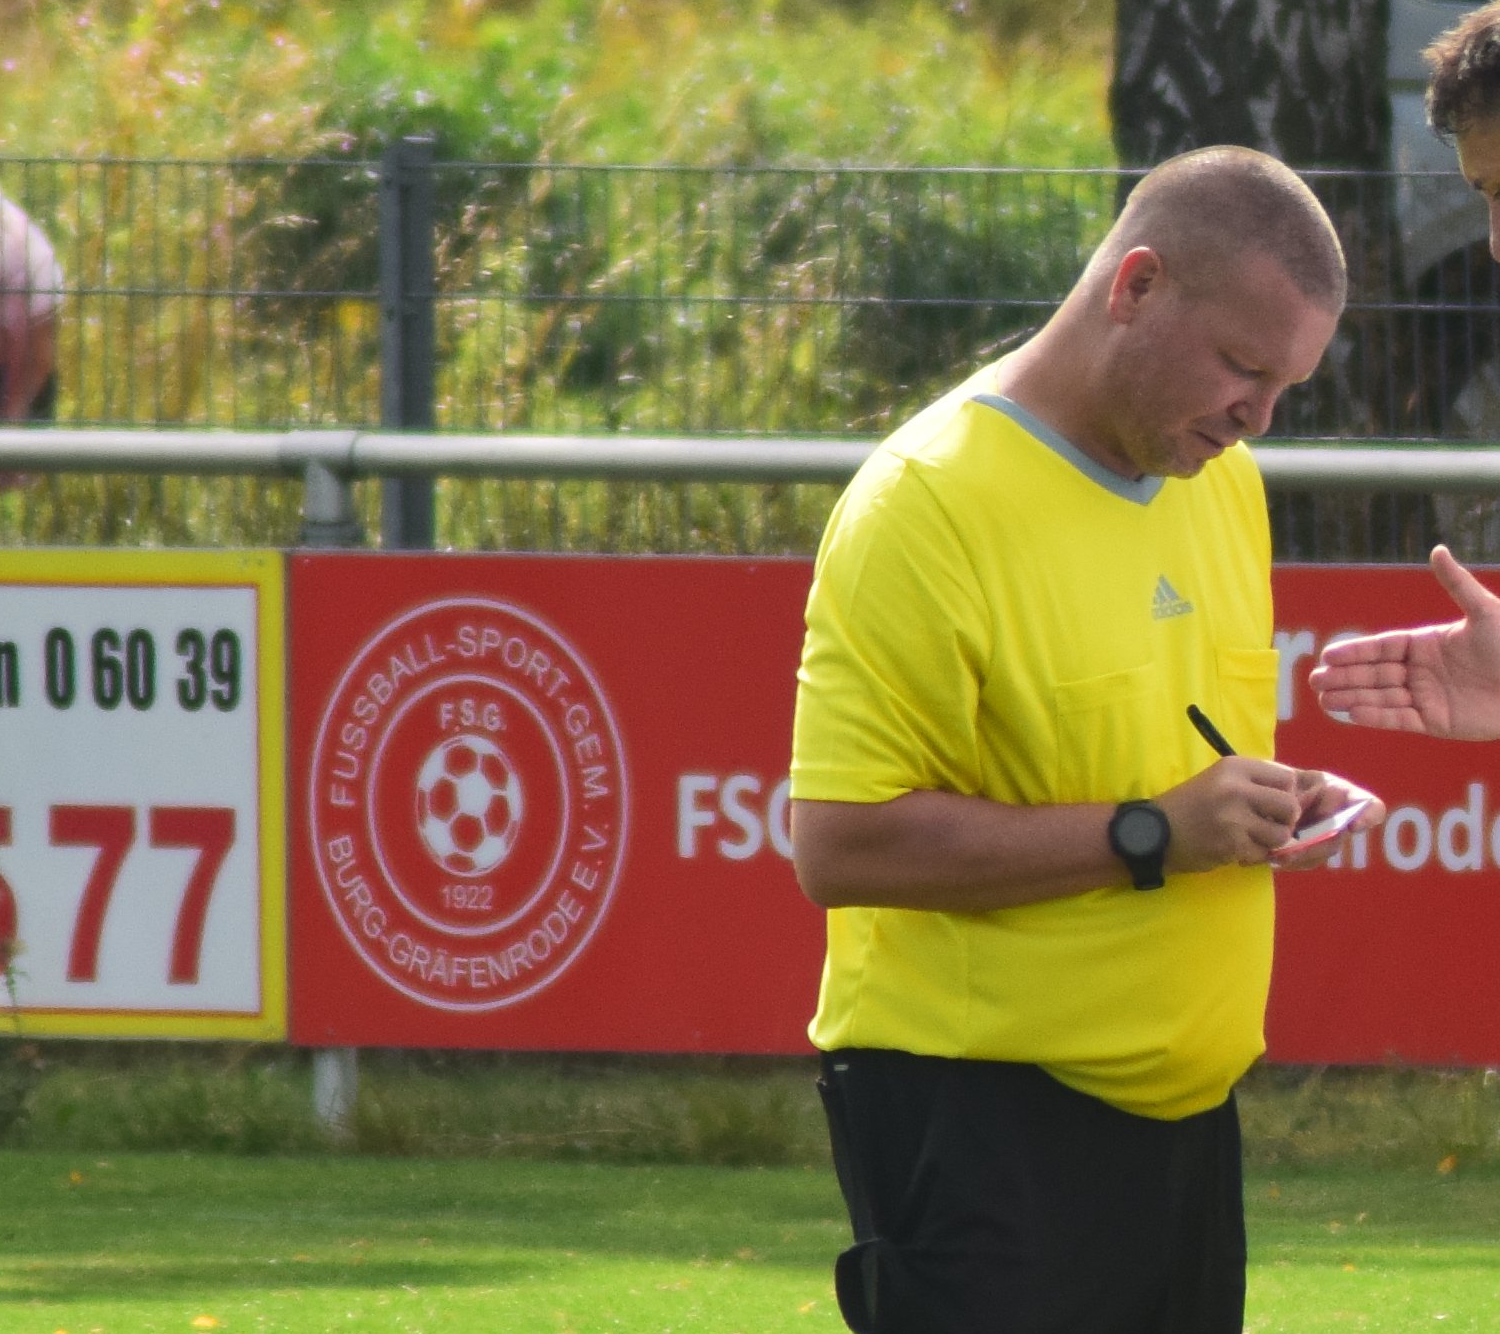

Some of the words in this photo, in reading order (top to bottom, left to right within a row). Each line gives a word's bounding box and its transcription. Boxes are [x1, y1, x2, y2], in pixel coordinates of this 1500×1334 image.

[44, 626, 76, 711] 0
[90, 627, 156, 710] 60
[176, 628, 242, 712] 39
[442, 884, 494, 911] 1922
